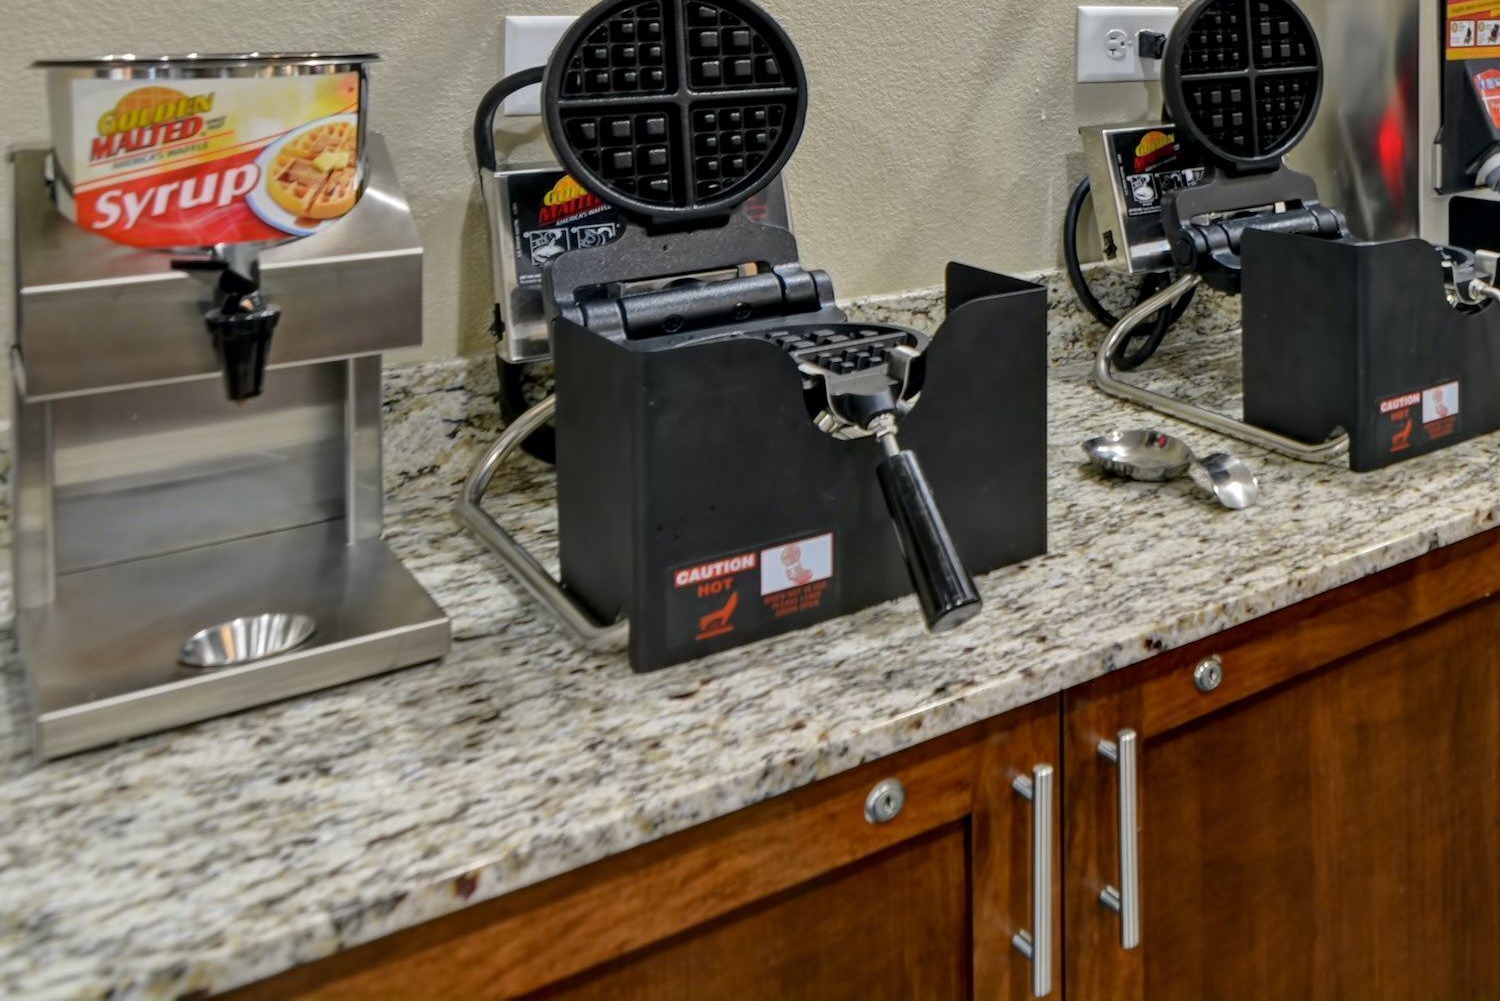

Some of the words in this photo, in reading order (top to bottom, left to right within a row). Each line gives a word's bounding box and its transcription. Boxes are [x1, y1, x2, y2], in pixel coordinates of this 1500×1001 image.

[98, 91, 215, 136] GOLDEN
[90, 116, 203, 162] MALTED
[93, 162, 262, 230] Syrup
[1380, 392, 1420, 413] CAUTION
[675, 554, 756, 586] CAUTION
[697, 578, 734, 597] HOT
